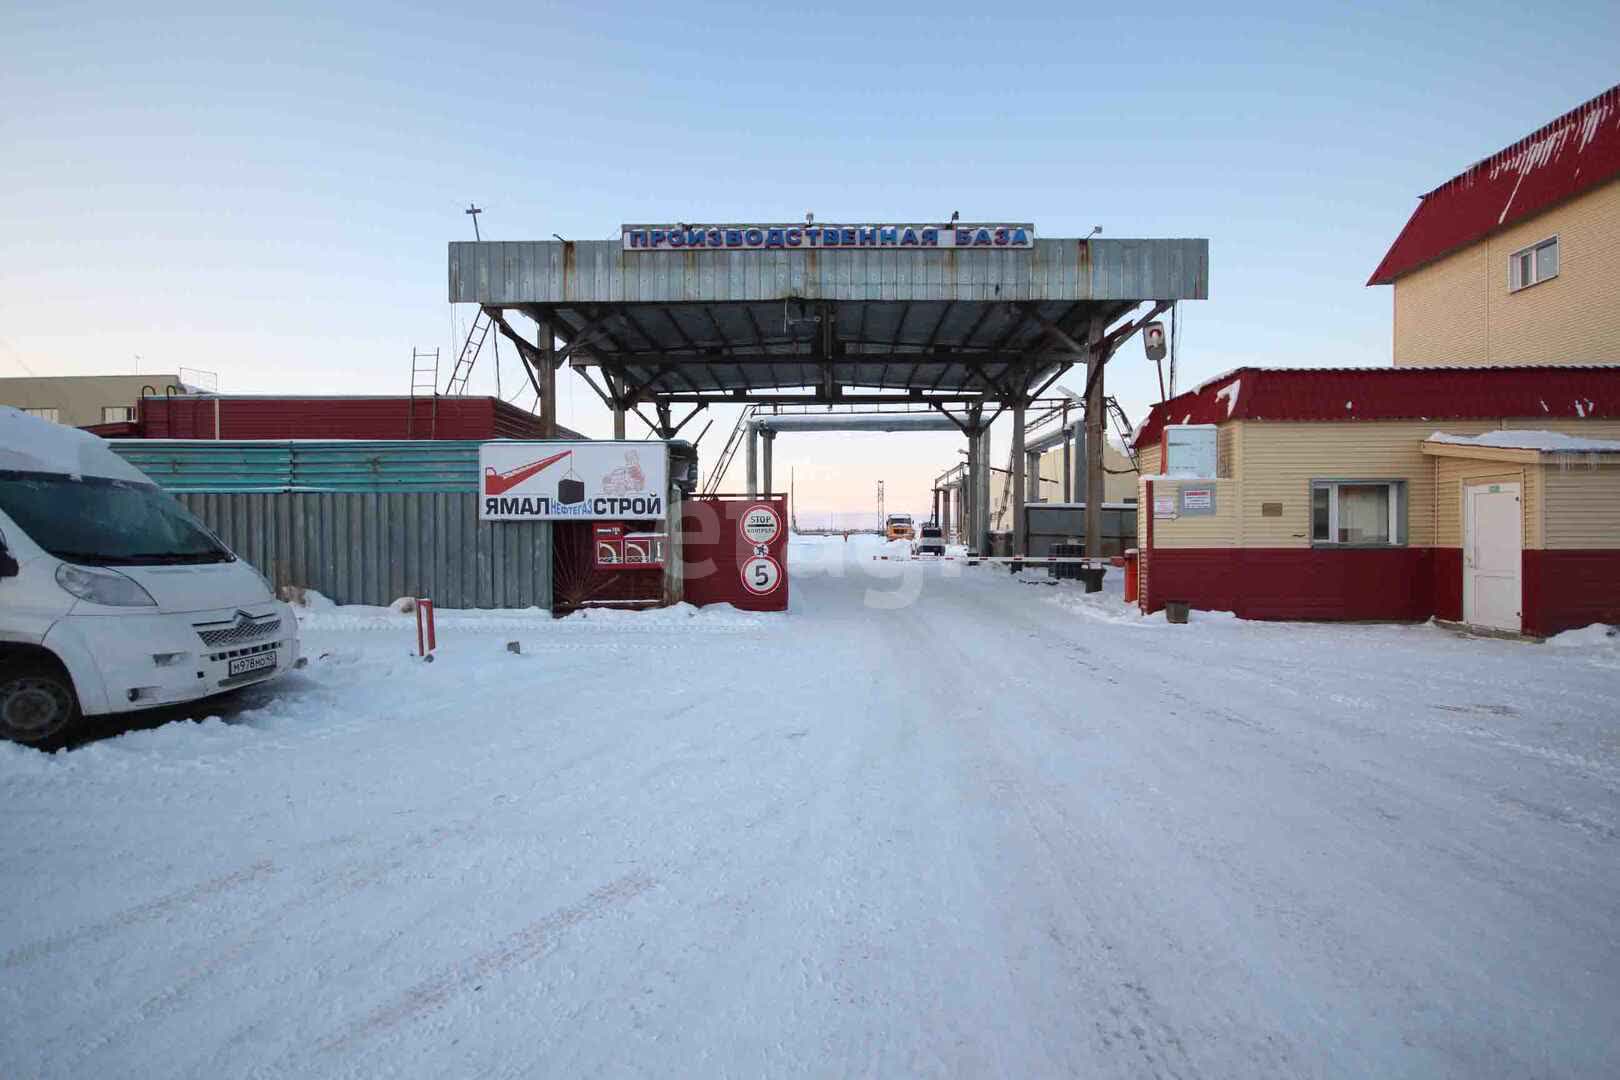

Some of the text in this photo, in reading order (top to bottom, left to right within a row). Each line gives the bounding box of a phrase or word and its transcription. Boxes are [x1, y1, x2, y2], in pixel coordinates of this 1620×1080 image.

[630, 227, 1029, 249] ПРОИЗВОДСТВЕННАЯ БАЗА
[594, 493, 661, 516] СТРОЙ
[750, 516, 771, 524] STOP
[755, 564, 769, 586] 5
